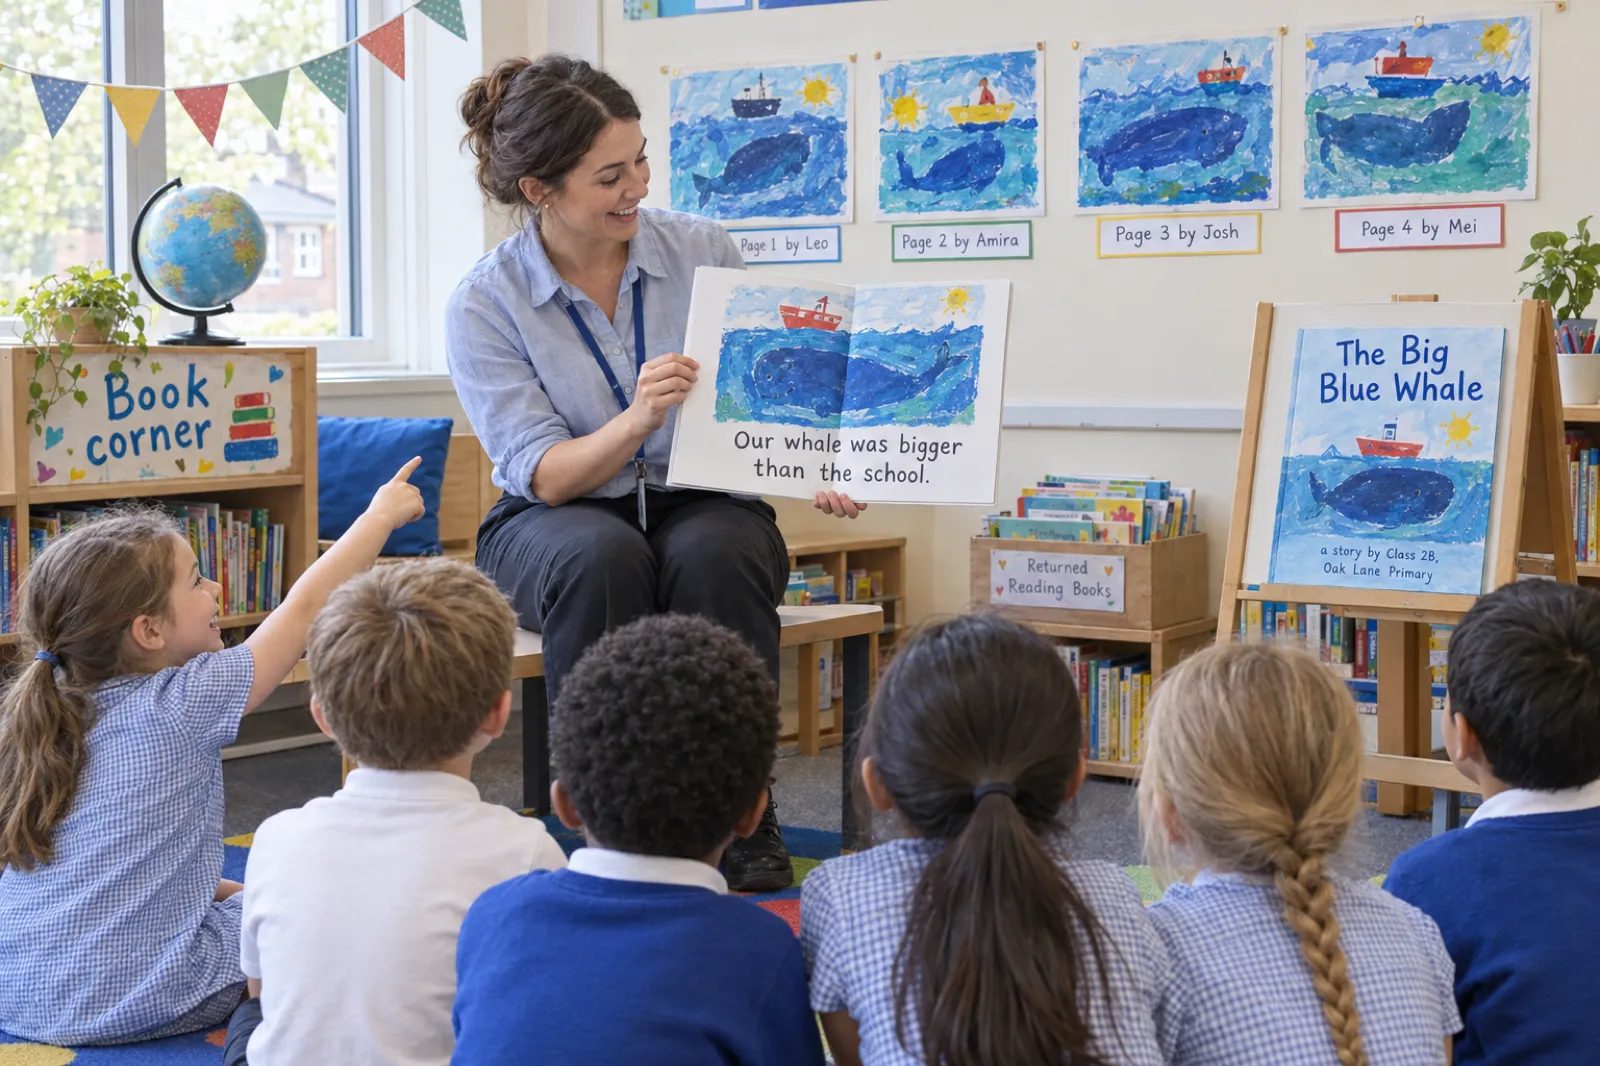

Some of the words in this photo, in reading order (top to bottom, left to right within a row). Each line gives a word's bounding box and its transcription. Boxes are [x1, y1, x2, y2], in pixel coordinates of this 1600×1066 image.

[900, 234, 932, 254] Page
[939, 233, 948, 249] 2
[954, 233, 970, 253] by
[976, 231, 1019, 249] Amira
[1116, 226, 1152, 248] Page
[1160, 225, 1170, 241] 3
[1178, 224, 1197, 248] by
[1203, 221, 1240, 241] Josh
[1361, 220, 1397, 244] Page
[1402, 218, 1413, 235] 4
[1421, 218, 1440, 240] by
[1449, 217, 1478, 235] Mei
[741, 238, 766, 253] Page
[771, 237, 777, 252] 1
[785, 237, 800, 256] by
[805, 235, 829, 251] Leo
[1336, 339, 1385, 366] The
[1402, 334, 1448, 375] Big
[104, 363, 210, 422] Book
[1320, 372, 1381, 404] Blue
[1394, 370, 1484, 402] Whale
[87, 419, 212, 466] corner
[734, 431, 775, 450] Our
[784, 432, 842, 453] whale
[850, 438, 888, 453] was
[899, 433, 963, 462] bigger
[754, 458, 805, 480] than
[819, 462, 852, 482] the
[863, 462, 930, 484] school.
[1027, 557, 1088, 576] Returned
[1320, 547, 1328, 556] a
[1333, 546, 1362, 560] story
[1368, 546, 1381, 562] by
[1386, 548, 1416, 561] Class
[1420, 550, 1440, 564] 2B,
[1323, 562, 1346, 575] Oak
[1353, 564, 1381, 577] Lane
[1389, 566, 1434, 585] Primary
[1008, 578, 1064, 601] Reading
[1073, 581, 1112, 599] Books
